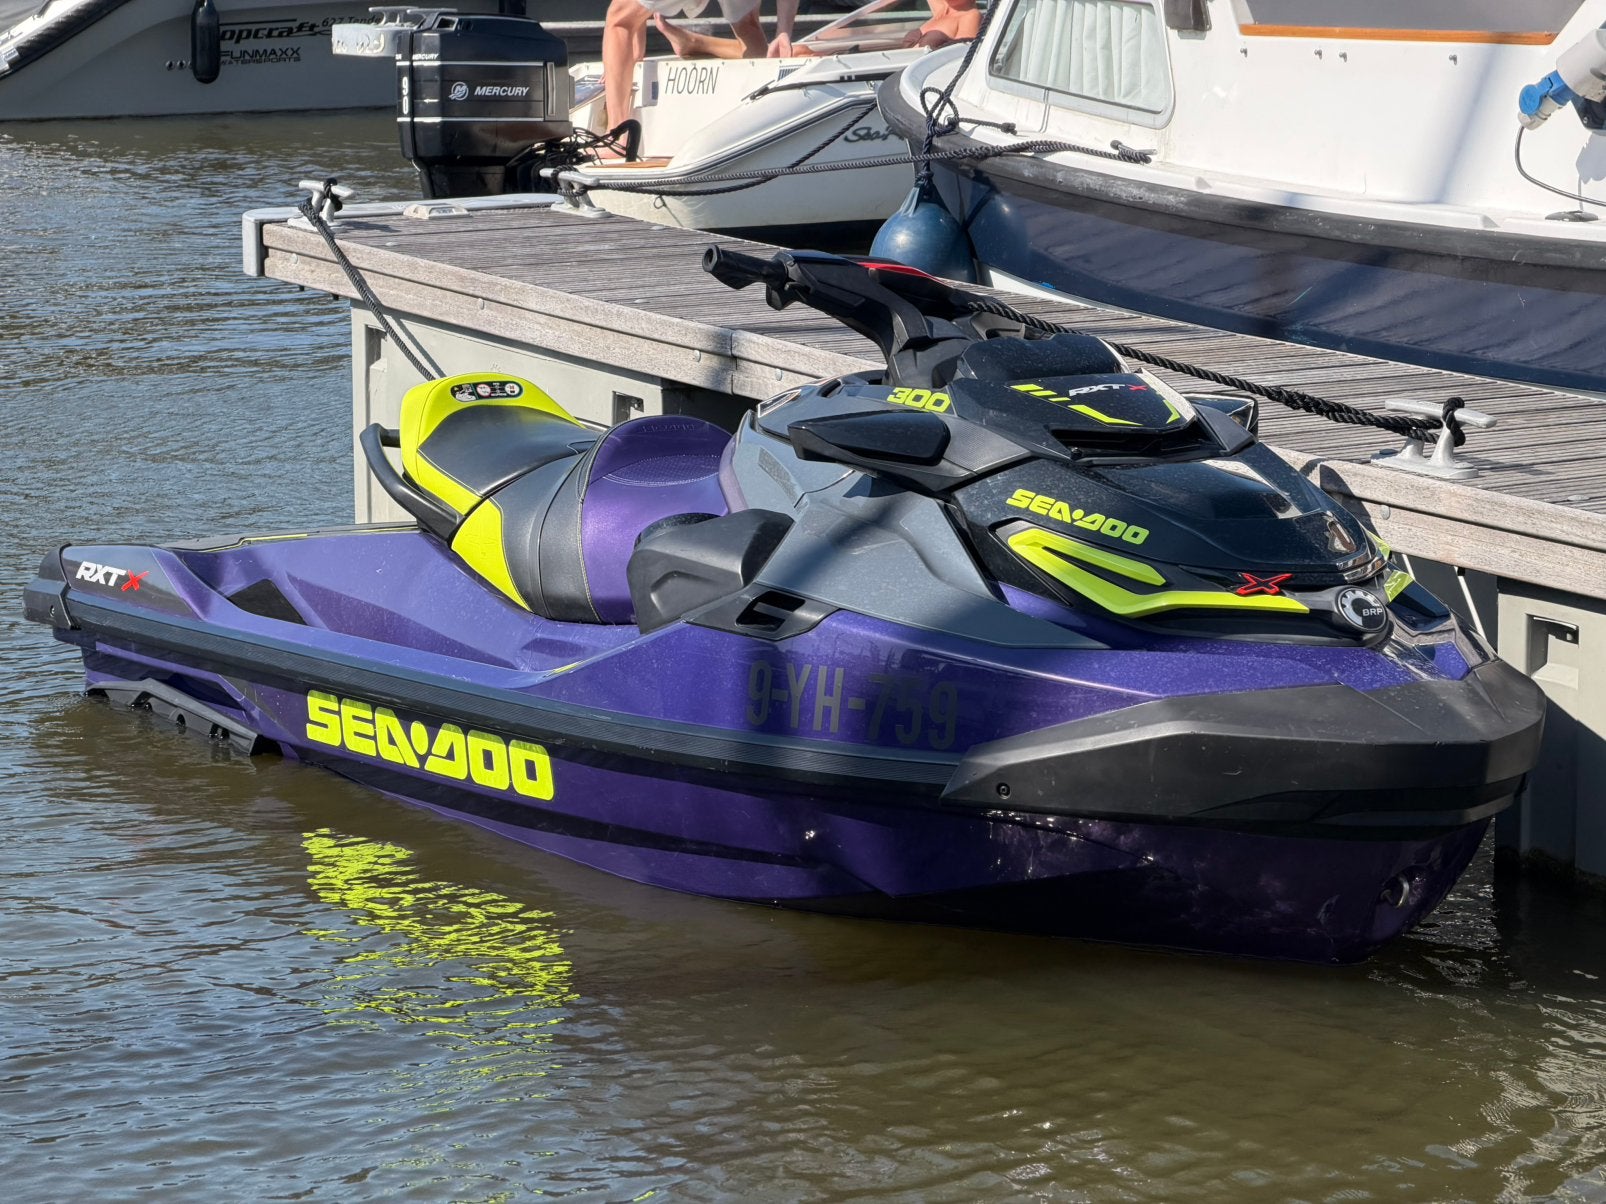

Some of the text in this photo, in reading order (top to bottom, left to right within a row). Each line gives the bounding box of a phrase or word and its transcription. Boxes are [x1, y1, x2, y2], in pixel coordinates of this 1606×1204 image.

[219, 19, 320, 44] opcraft
[474, 86, 530, 97] MERCURY
[664, 66, 720, 95] HOORN
[887, 387, 951, 413] 300
[1362, 608, 1383, 617] BRP
[747, 659, 958, 750] 9-YH-759
